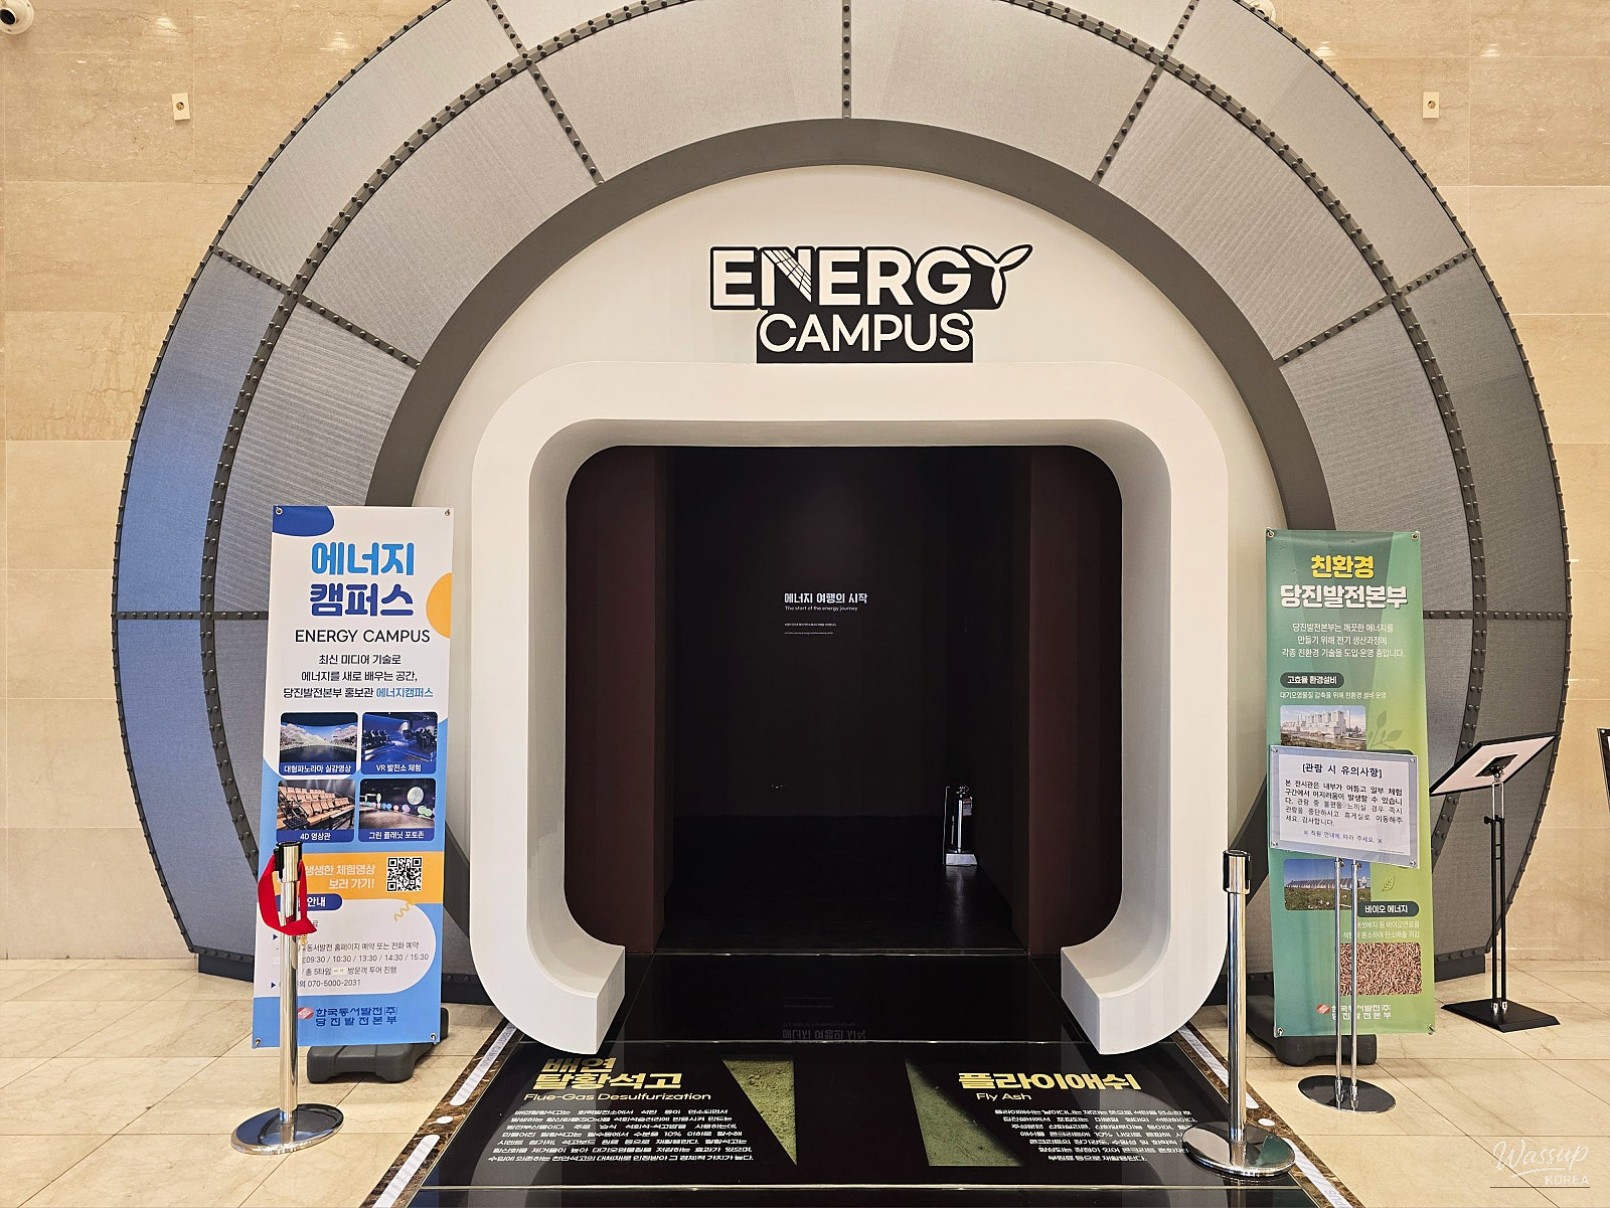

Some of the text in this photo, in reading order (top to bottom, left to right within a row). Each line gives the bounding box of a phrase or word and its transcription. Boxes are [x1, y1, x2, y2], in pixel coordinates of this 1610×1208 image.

[711, 246, 1031, 308] ENERGY
[759, 312, 971, 352] CAMPUS
[311, 541, 414, 576] 에너지
[1311, 555, 1374, 579] 친환경
[310, 583, 414, 617] 캠퍼스
[785, 593, 868, 604] 에너지 여행의 시작
[1280, 585, 1408, 609] 당진발전본부
[1293, 623, 1342, 633] 당진발전본부는
[1366, 623, 1394, 633] 에너지를
[295, 630, 430, 643] ENERGY CAMPUS
[1298, 636, 1388, 645] 만들기 위해 전기 생산과정에
[1282, 648, 1295, 658] 각종
[1298, 648, 1319, 658] 친환경
[1322, 648, 1342, 658] 기술을
[319, 654, 401, 665] 최신 미디어 기술로
[301, 671, 417, 682] 에너지를 새로 배우는 공간,
[1288, 675, 1337, 685] 고효율 환경설비
[283, 688, 433, 699] 당진발전본부 홍보관 에너지캠퍼스
[326, 765, 351, 773] 실감영상
[376, 764, 421, 772] VR 발전소 체험
[1328, 765, 1336, 774] 시
[1295, 781, 1319, 789] 전시관은
[1323, 783, 1342, 791] 내부가
[1346, 785, 1366, 793] 어둡고
[1370, 786, 1384, 794] 일부
[1388, 788, 1402, 796] 체험
[1285, 788, 1309, 797] 구간에서
[1313, 790, 1344, 800] 어지러움이
[1348, 794, 1367, 803] 발생할
[1381, 797, 1402, 805] 있습니
[1308, 808, 1339, 817] 중단하시고
[1347, 803, 1366, 811] 느끼실
[1372, 805, 1384, 813] 경우
[1389, 806, 1402, 814] 즉시
[1302, 816, 1334, 826] 감사합니다.
[369, 832, 382, 840] 그린
[337, 864, 375, 876] 체험영상
[329, 879, 375, 889] 보러 가기!
[307, 896, 326, 908] 안내
[1365, 905, 1408, 914] 바이오 에너지
[335, 943, 360, 952] 홈페이지
[362, 943, 375, 952] 예약
[377, 943, 389, 952] 또는
[391, 943, 404, 951] 전화
[406, 942, 419, 951] 예약
[333, 955, 351, 963] 10:30
[385, 954, 404, 962] 14:30
[306, 968, 312, 976] 총
[314, 968, 332, 976] 5타임
[348, 967, 368, 975] 방문객
[384, 966, 397, 974] 진행
[541, 1057, 616, 1073] 배연
[533, 1073, 682, 1090] 탈황석고
[959, 1073, 1142, 1090] 플라이애쉬
[524, 1093, 711, 1101] Flue-Gas Desulfurization
[977, 1093, 1032, 1101] Fly Ash
